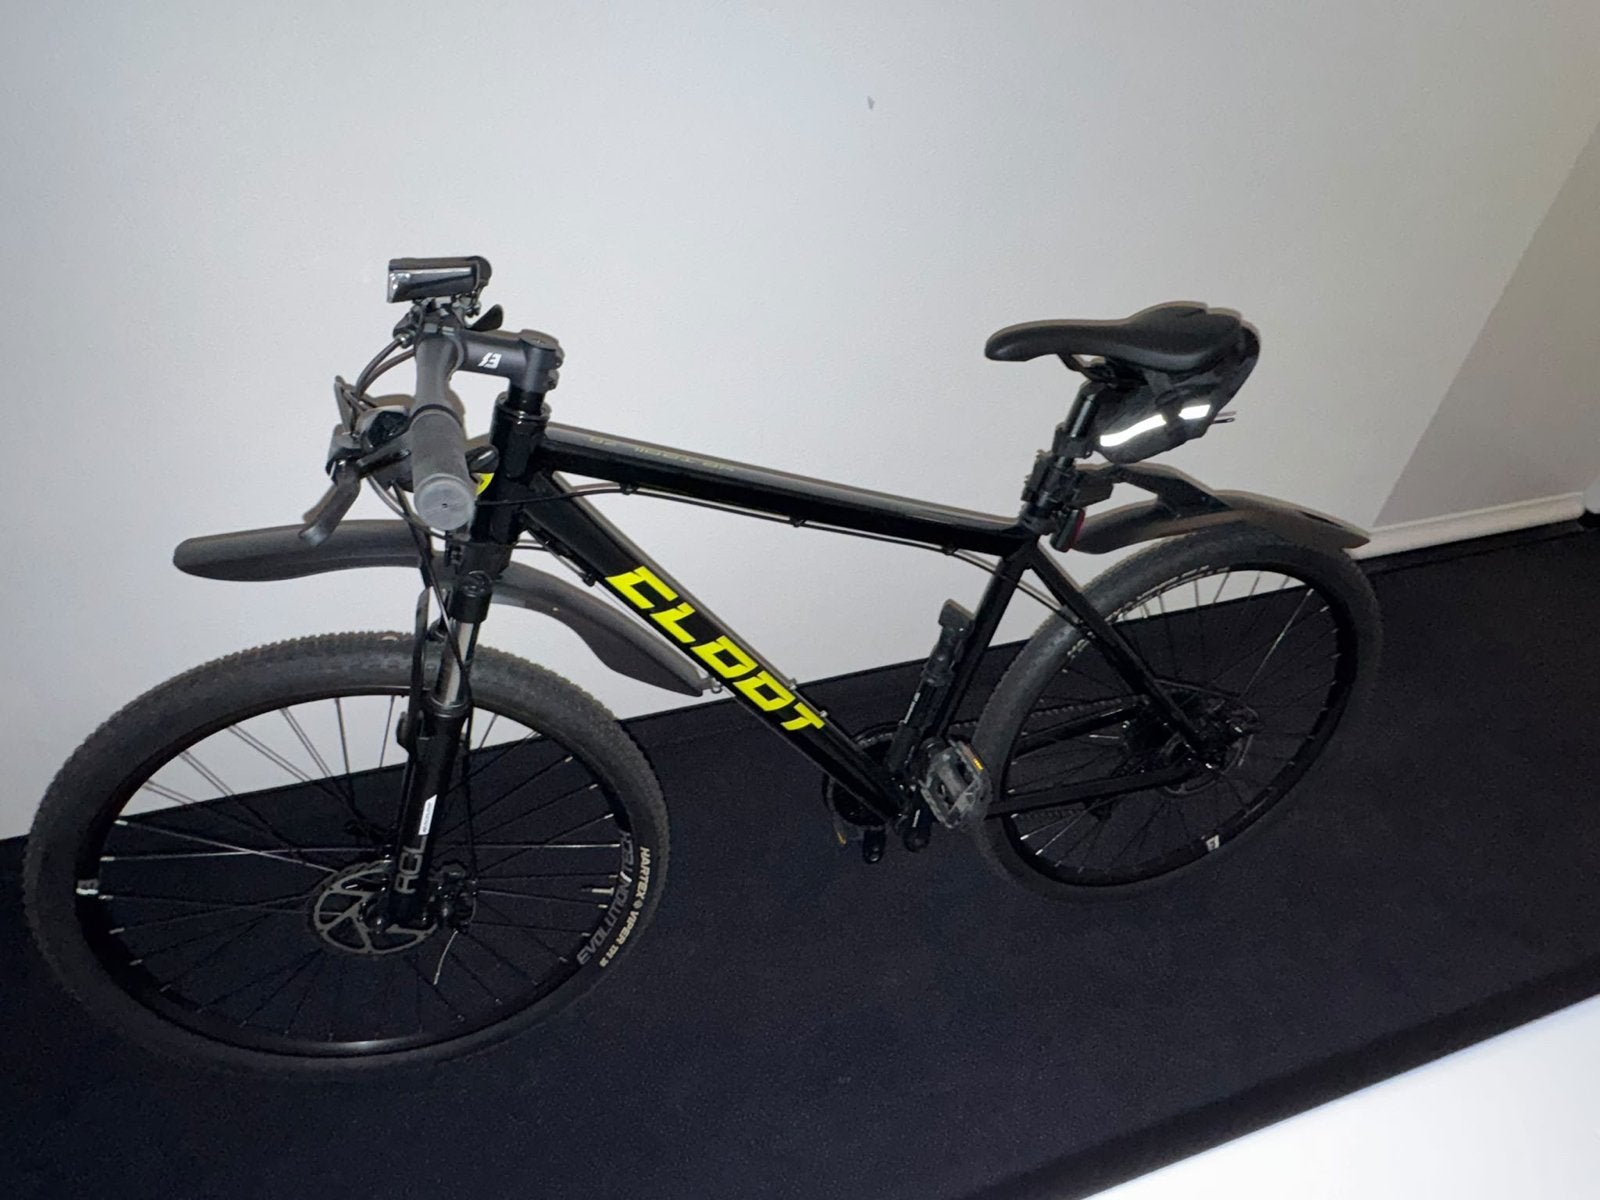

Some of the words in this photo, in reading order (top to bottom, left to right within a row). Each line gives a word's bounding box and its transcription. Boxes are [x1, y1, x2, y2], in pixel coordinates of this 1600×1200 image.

[605, 566, 825, 730] CLOOT
[636, 846, 651, 899] HARTEX
[616, 910, 639, 945] VIPER
